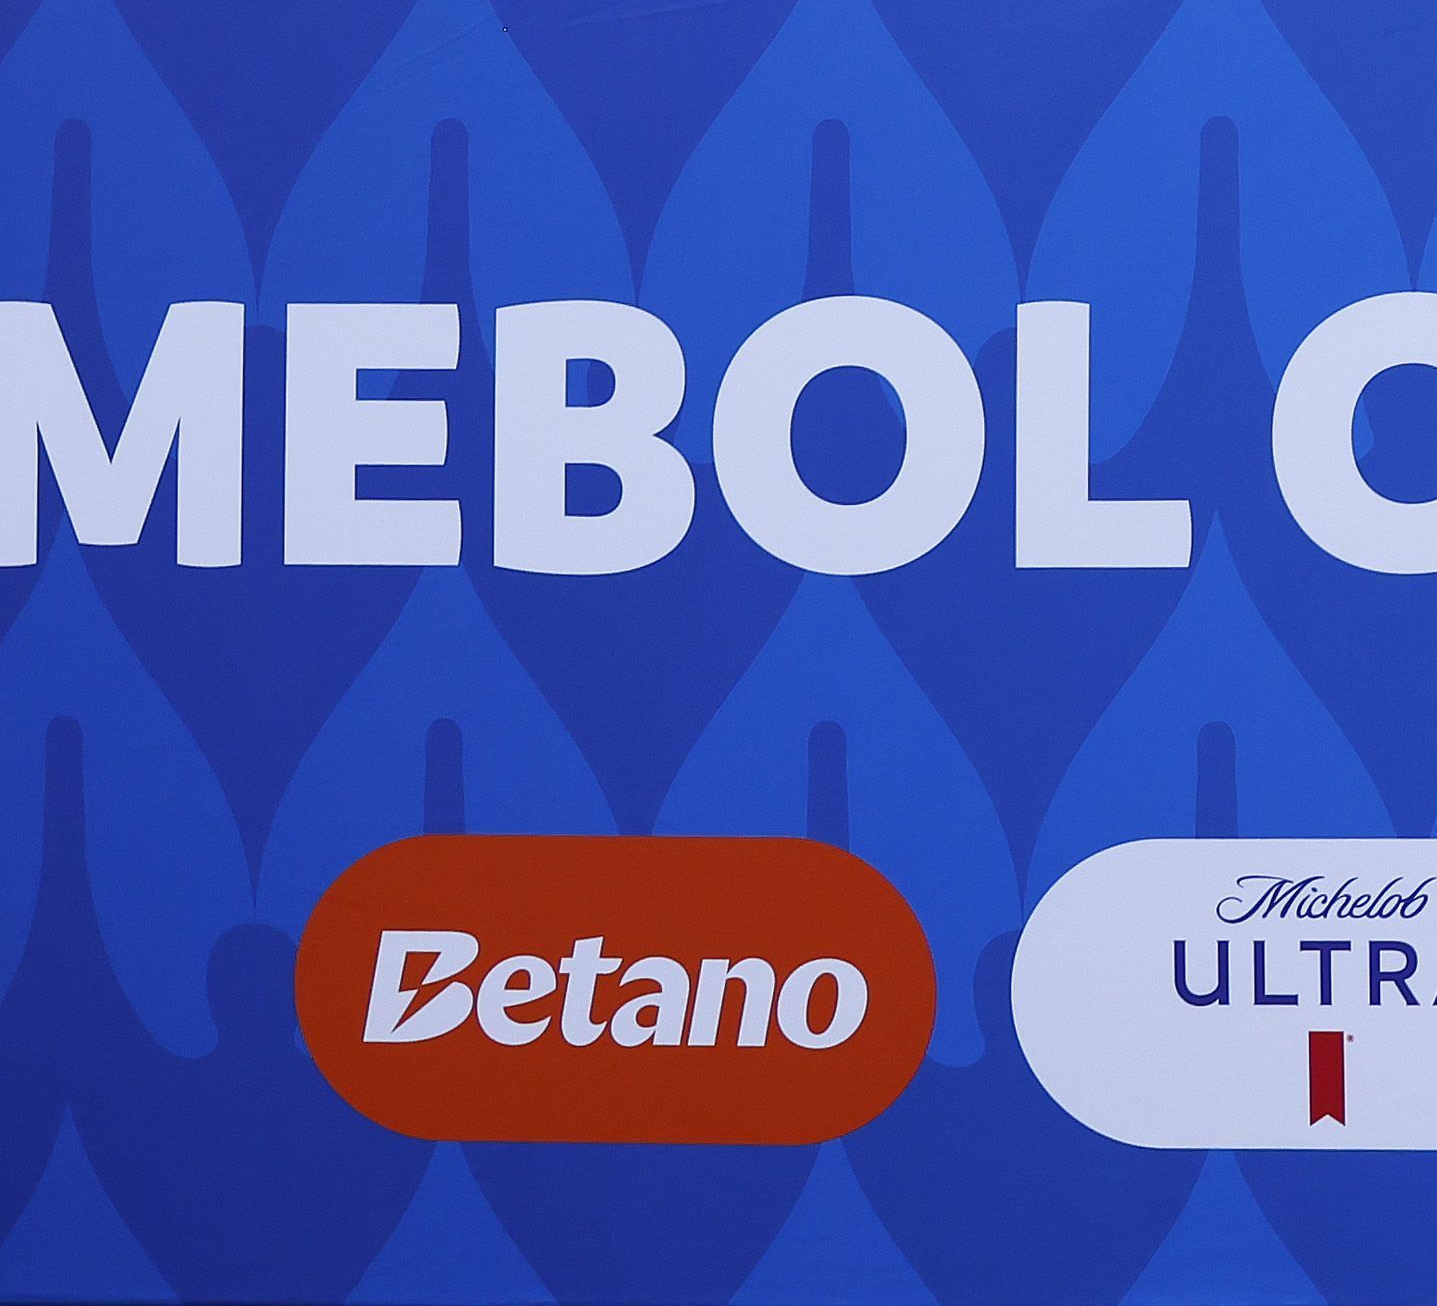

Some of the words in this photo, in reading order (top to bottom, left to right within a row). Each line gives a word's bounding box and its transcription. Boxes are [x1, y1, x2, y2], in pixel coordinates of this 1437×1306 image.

[0, 294, 1193, 576] MEBOL
[1215, 874, 1437, 925] Michelob
[362, 929, 868, 1050] Betano
